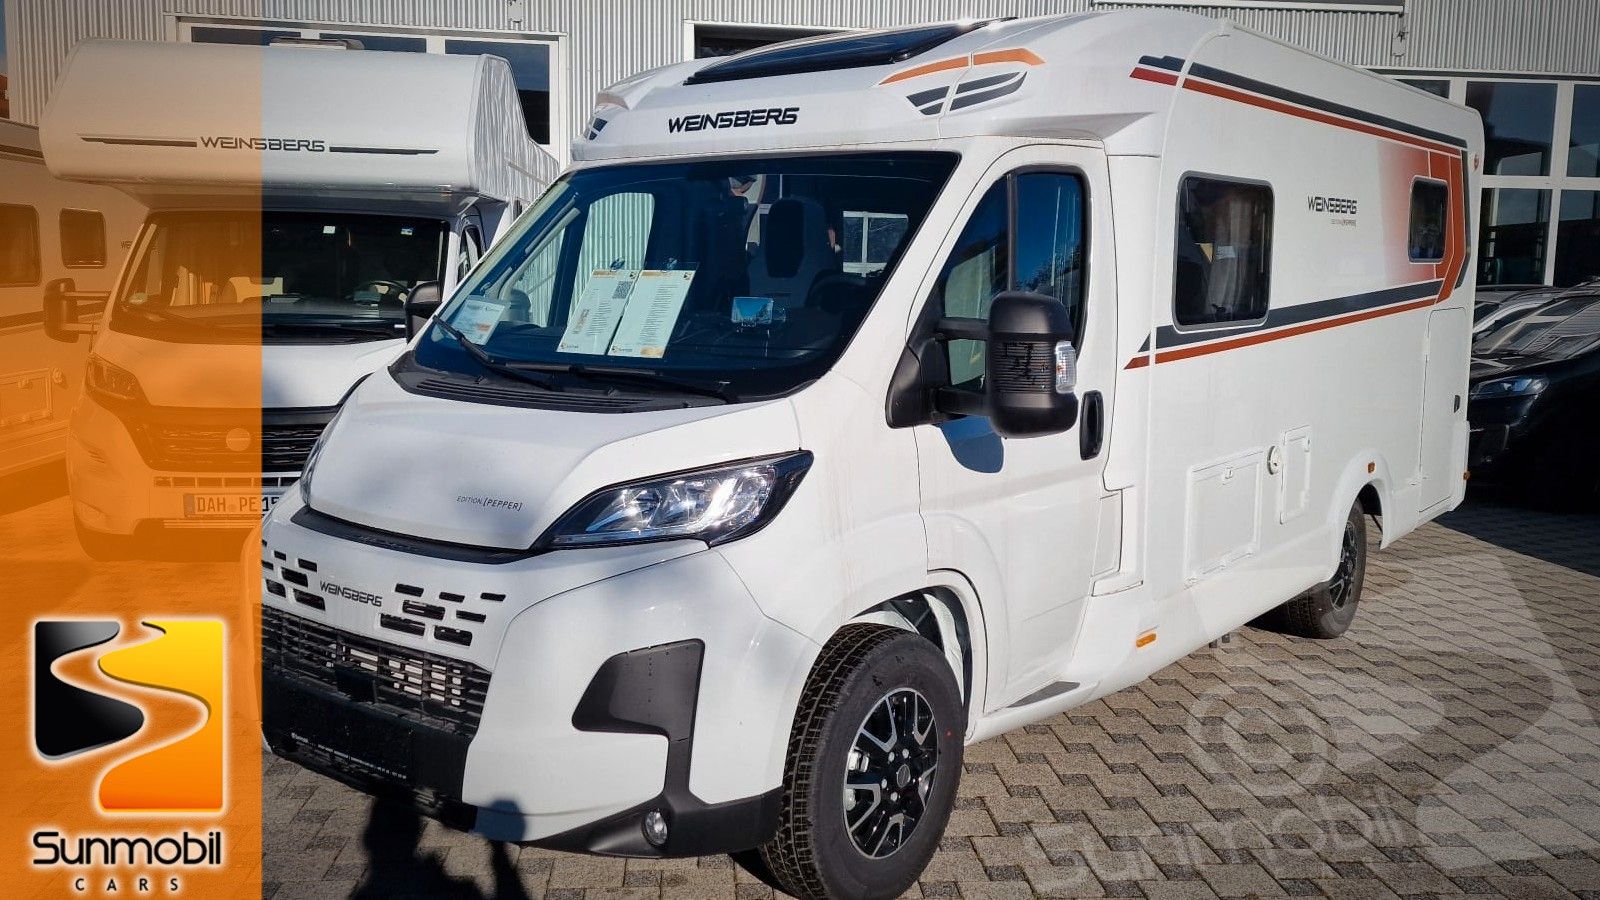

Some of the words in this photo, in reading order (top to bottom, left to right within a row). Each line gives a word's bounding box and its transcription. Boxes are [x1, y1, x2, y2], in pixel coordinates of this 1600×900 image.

[668, 107, 800, 134] WEINSBERG
[200, 136, 325, 153] WEINSBERG
[1307, 196, 1358, 215] WEINSBERG
[197, 497, 227, 512] DAH
[239, 497, 259, 512] PE
[456, 495, 483, 505] EDITION
[320, 580, 383, 608] WEINSBERG
